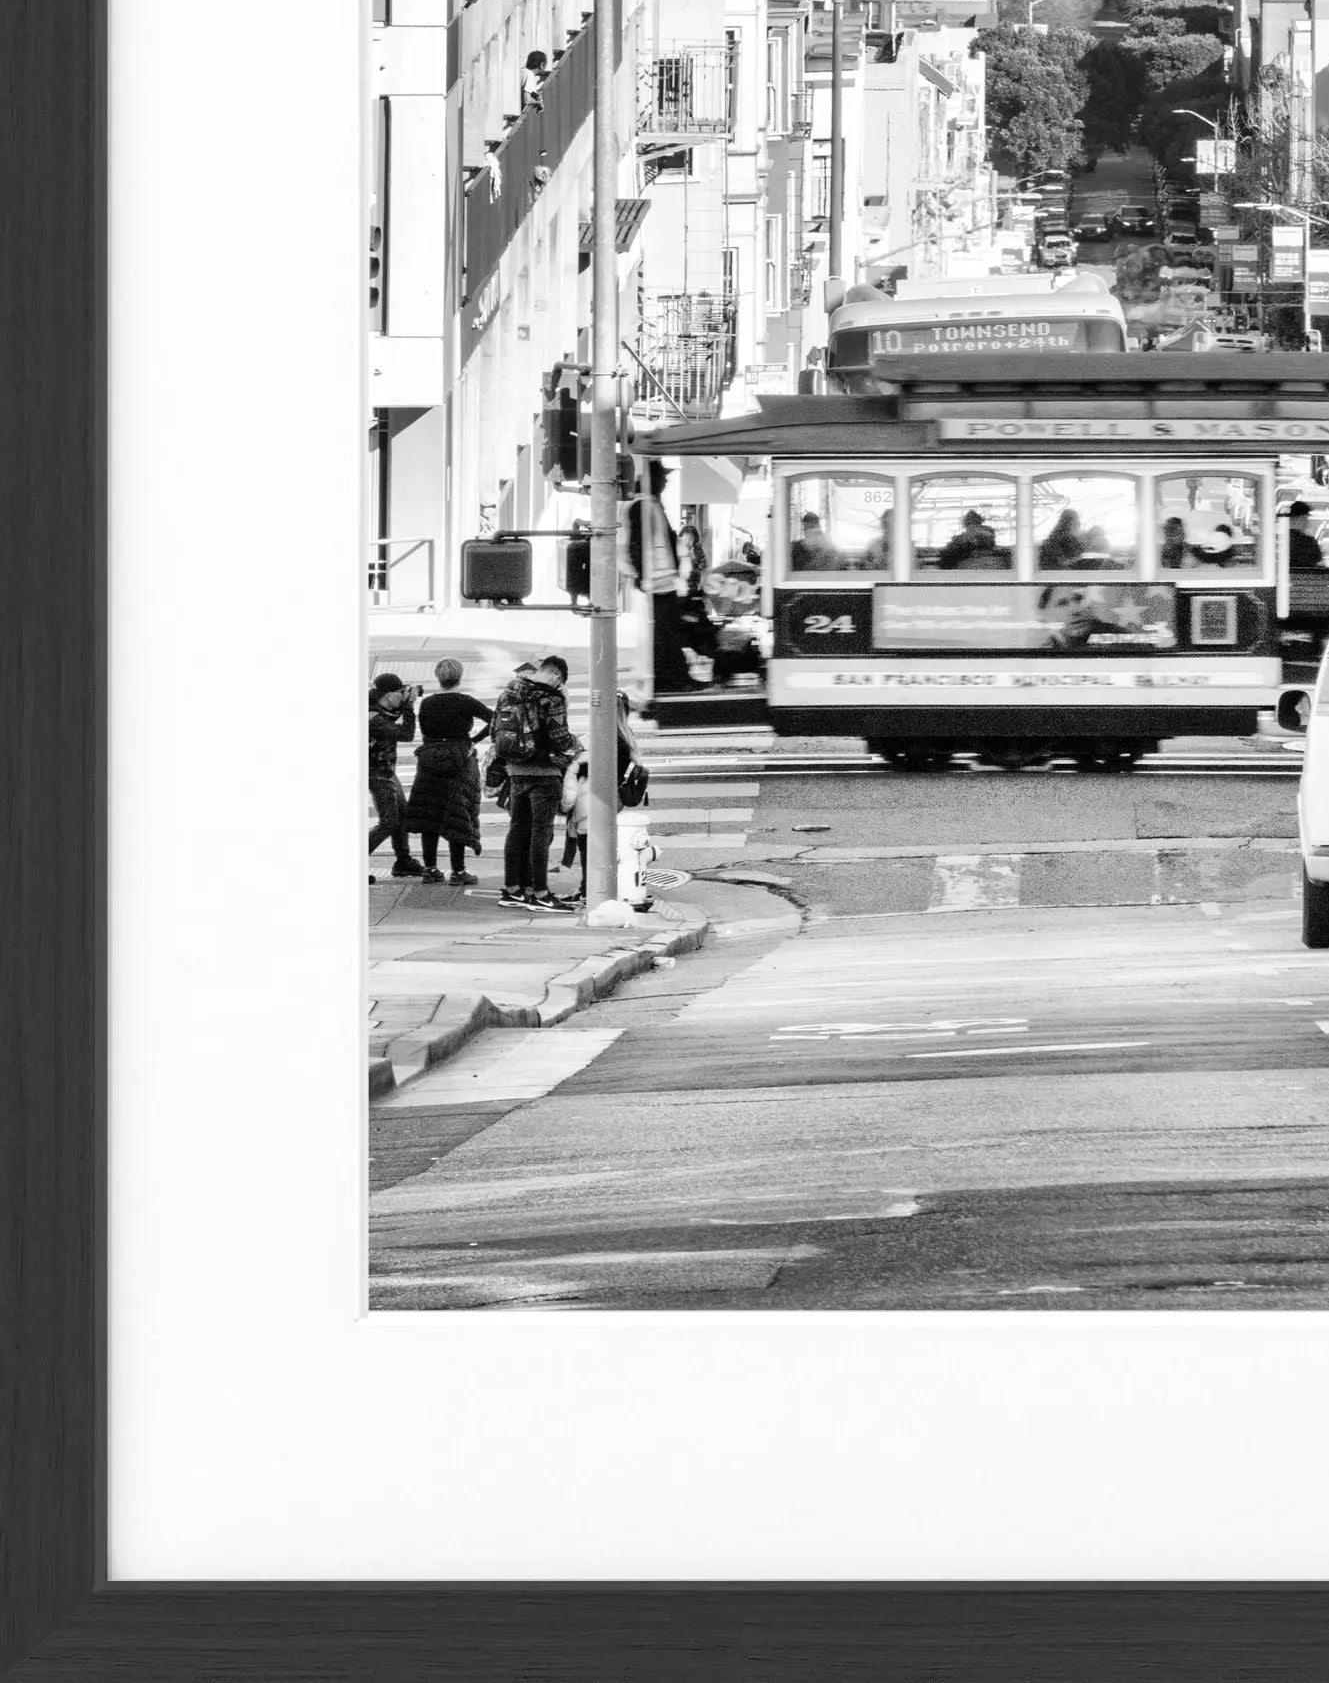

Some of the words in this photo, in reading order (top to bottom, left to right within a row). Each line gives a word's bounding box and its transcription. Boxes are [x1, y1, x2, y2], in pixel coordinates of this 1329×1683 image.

[931, 322, 1050, 341] TOWNSEND
[872, 329, 902, 355] 10
[913, 335, 1069, 354] Potrero+24th
[746, 373, 757, 383] NO
[965, 422, 1133, 437] POWELL
[863, 491, 892, 503] 862
[803, 614, 857, 634] 24
